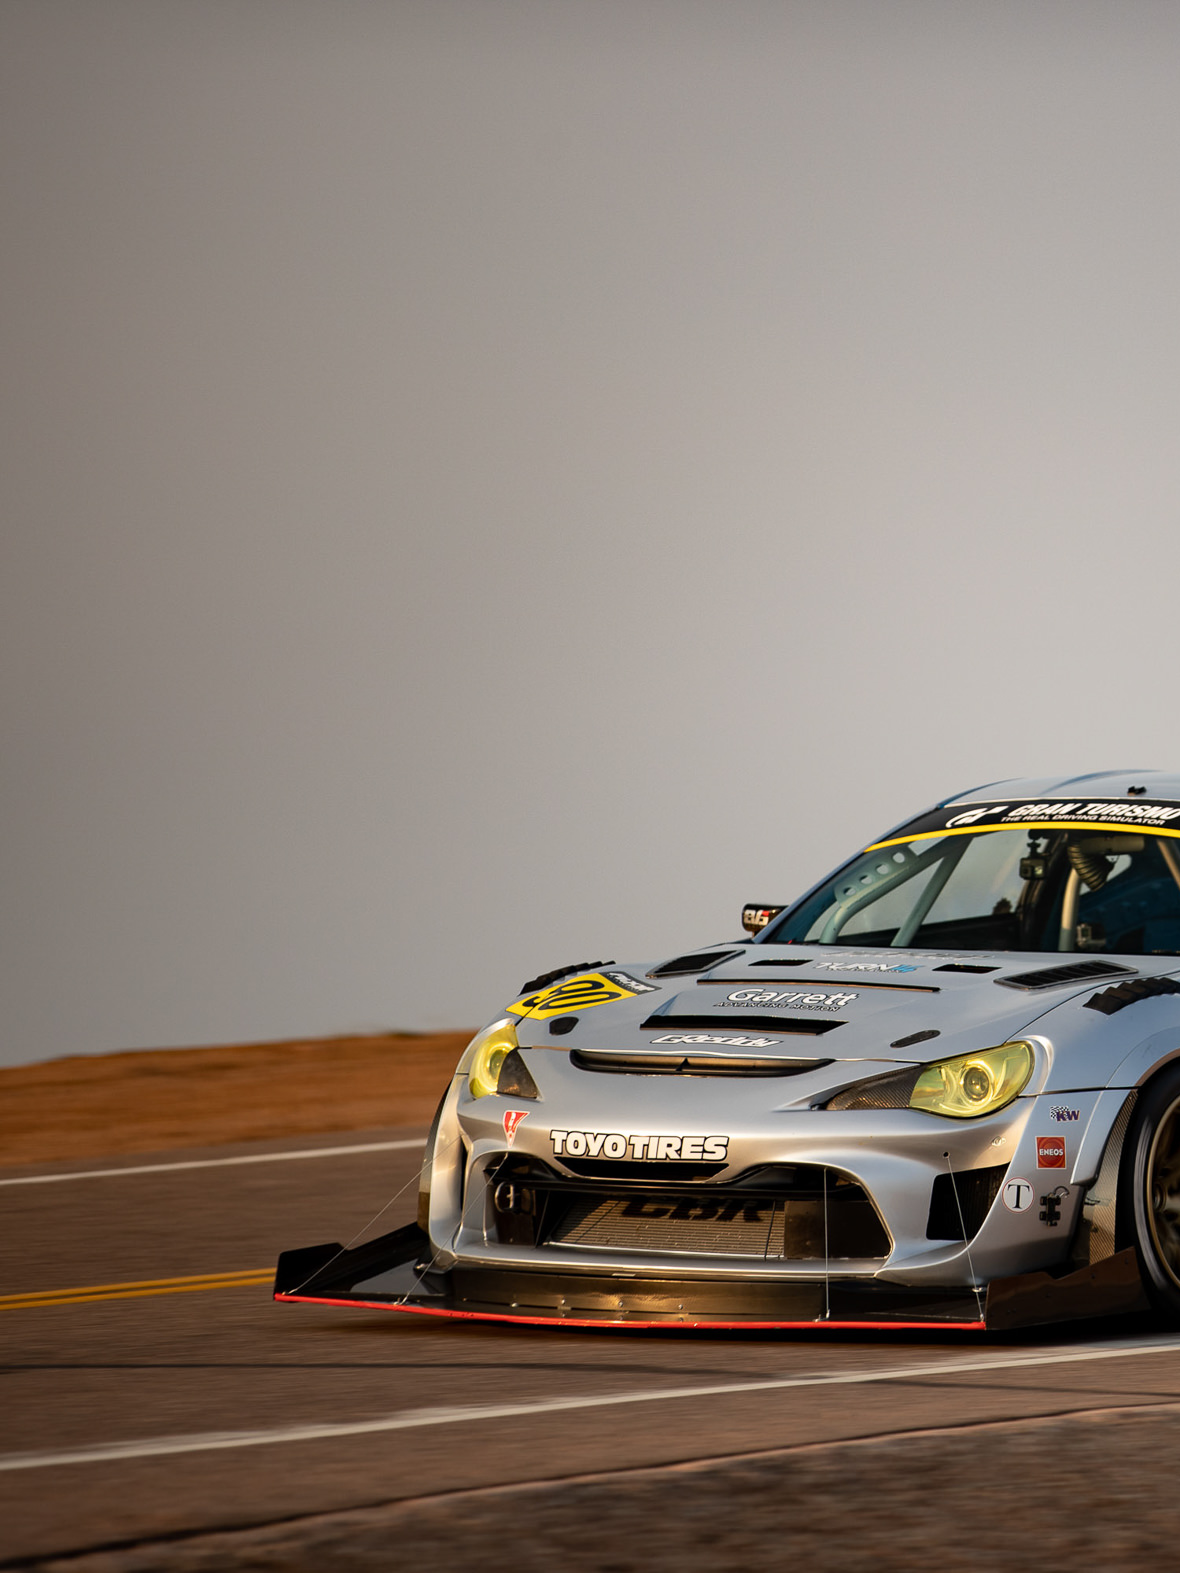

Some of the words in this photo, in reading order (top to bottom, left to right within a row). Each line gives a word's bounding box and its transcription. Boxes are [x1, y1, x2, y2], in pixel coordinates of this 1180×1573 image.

[1007, 803, 1078, 817] GRAN
[1051, 814, 1097, 822] DRIVING
[1098, 815, 1166, 826] SIMULATOR
[726, 988, 860, 1006] Garrett
[713, 1001, 788, 1009] ADVANCING
[789, 1003, 841, 1012] MOTION
[1056, 1110, 1080, 1121] KW
[550, 1130, 628, 1158] TOYO
[627, 1134, 730, 1161] TIRES
[1039, 1148, 1064, 1156] ENEOS
[1007, 1184, 1030, 1209] T
